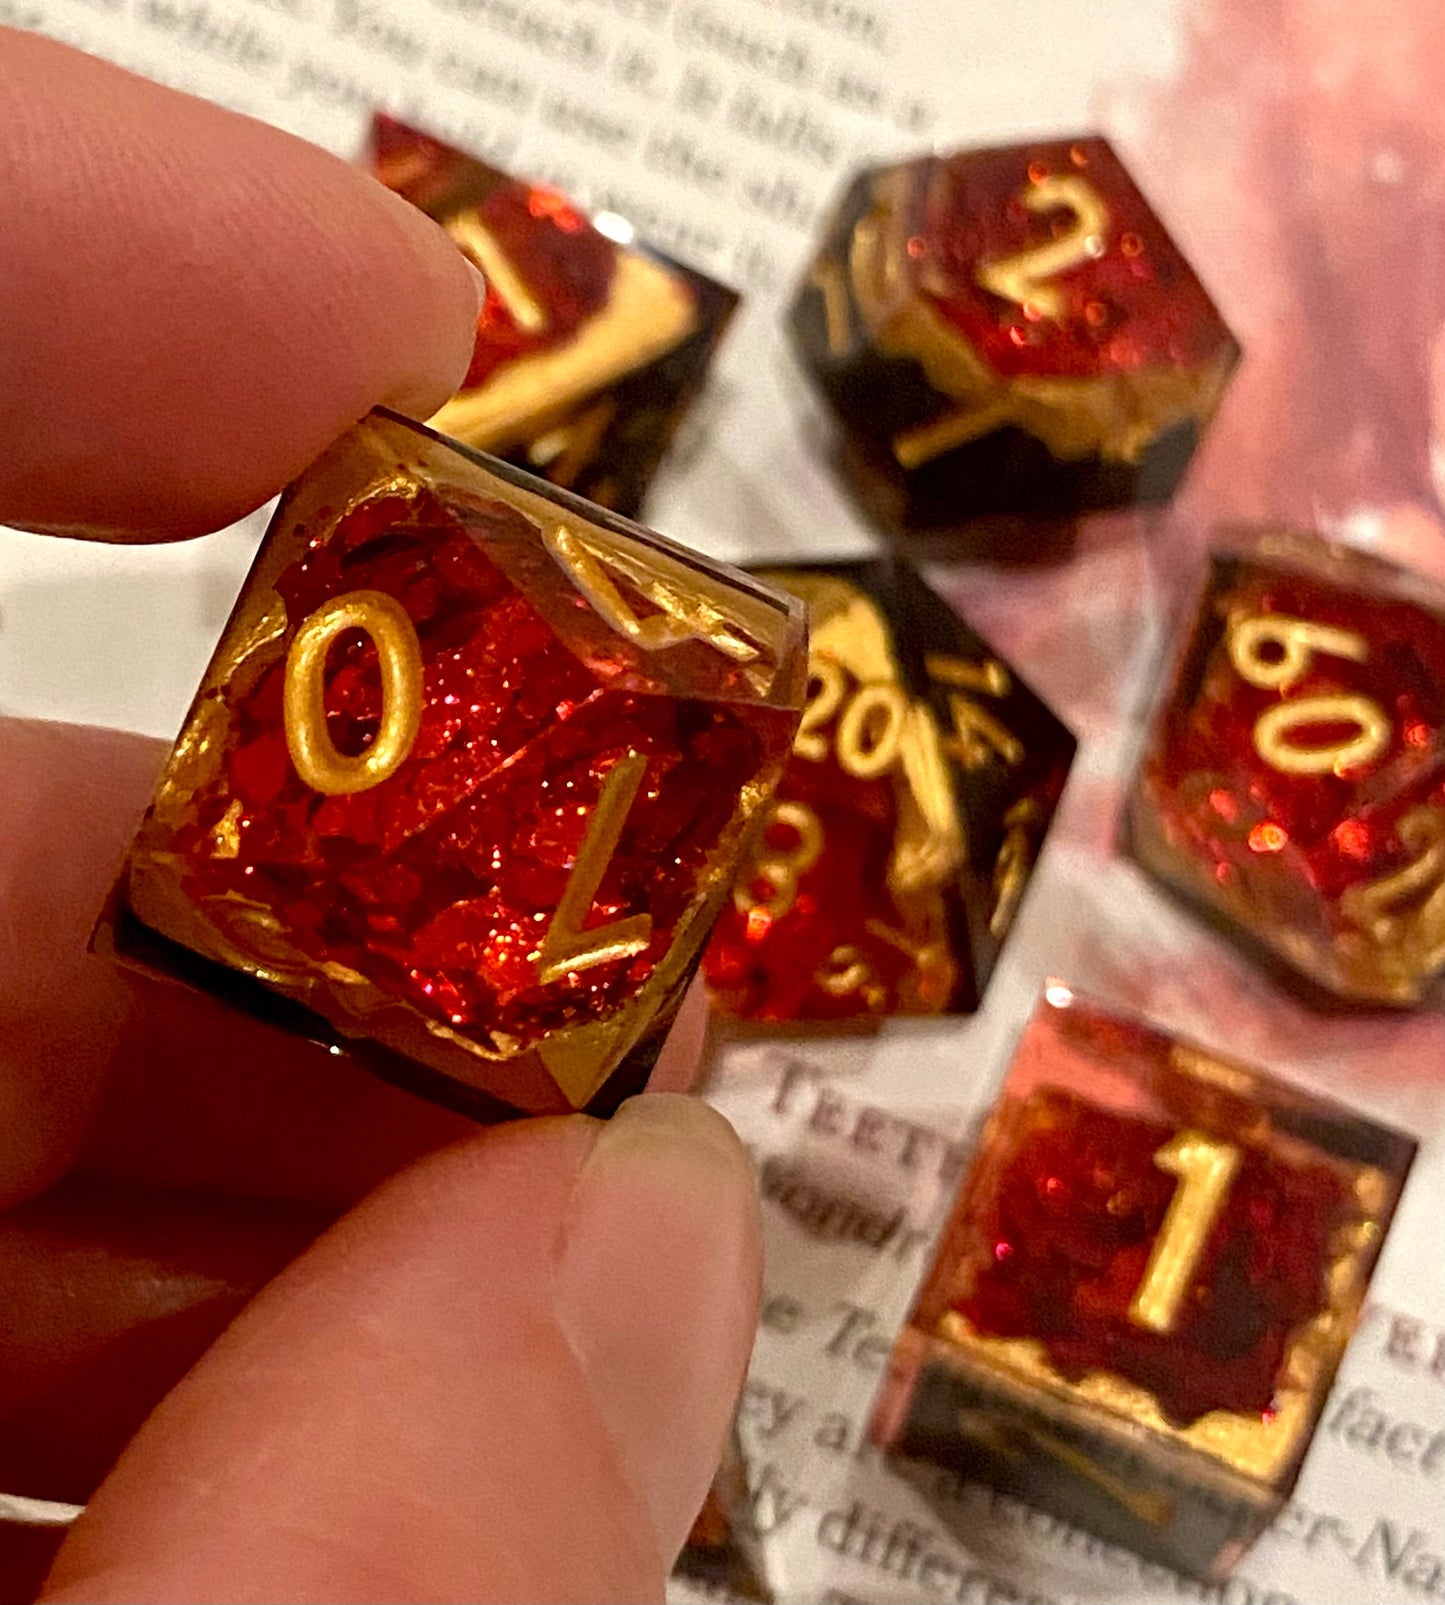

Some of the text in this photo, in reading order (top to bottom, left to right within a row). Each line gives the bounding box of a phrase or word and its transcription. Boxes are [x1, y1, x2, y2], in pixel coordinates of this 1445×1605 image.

[975, 172, 1108, 322] 2
[284, 590, 423, 795] 0
[793, 662, 905, 778] 20
[1128, 1132, 1240, 1334] 1
